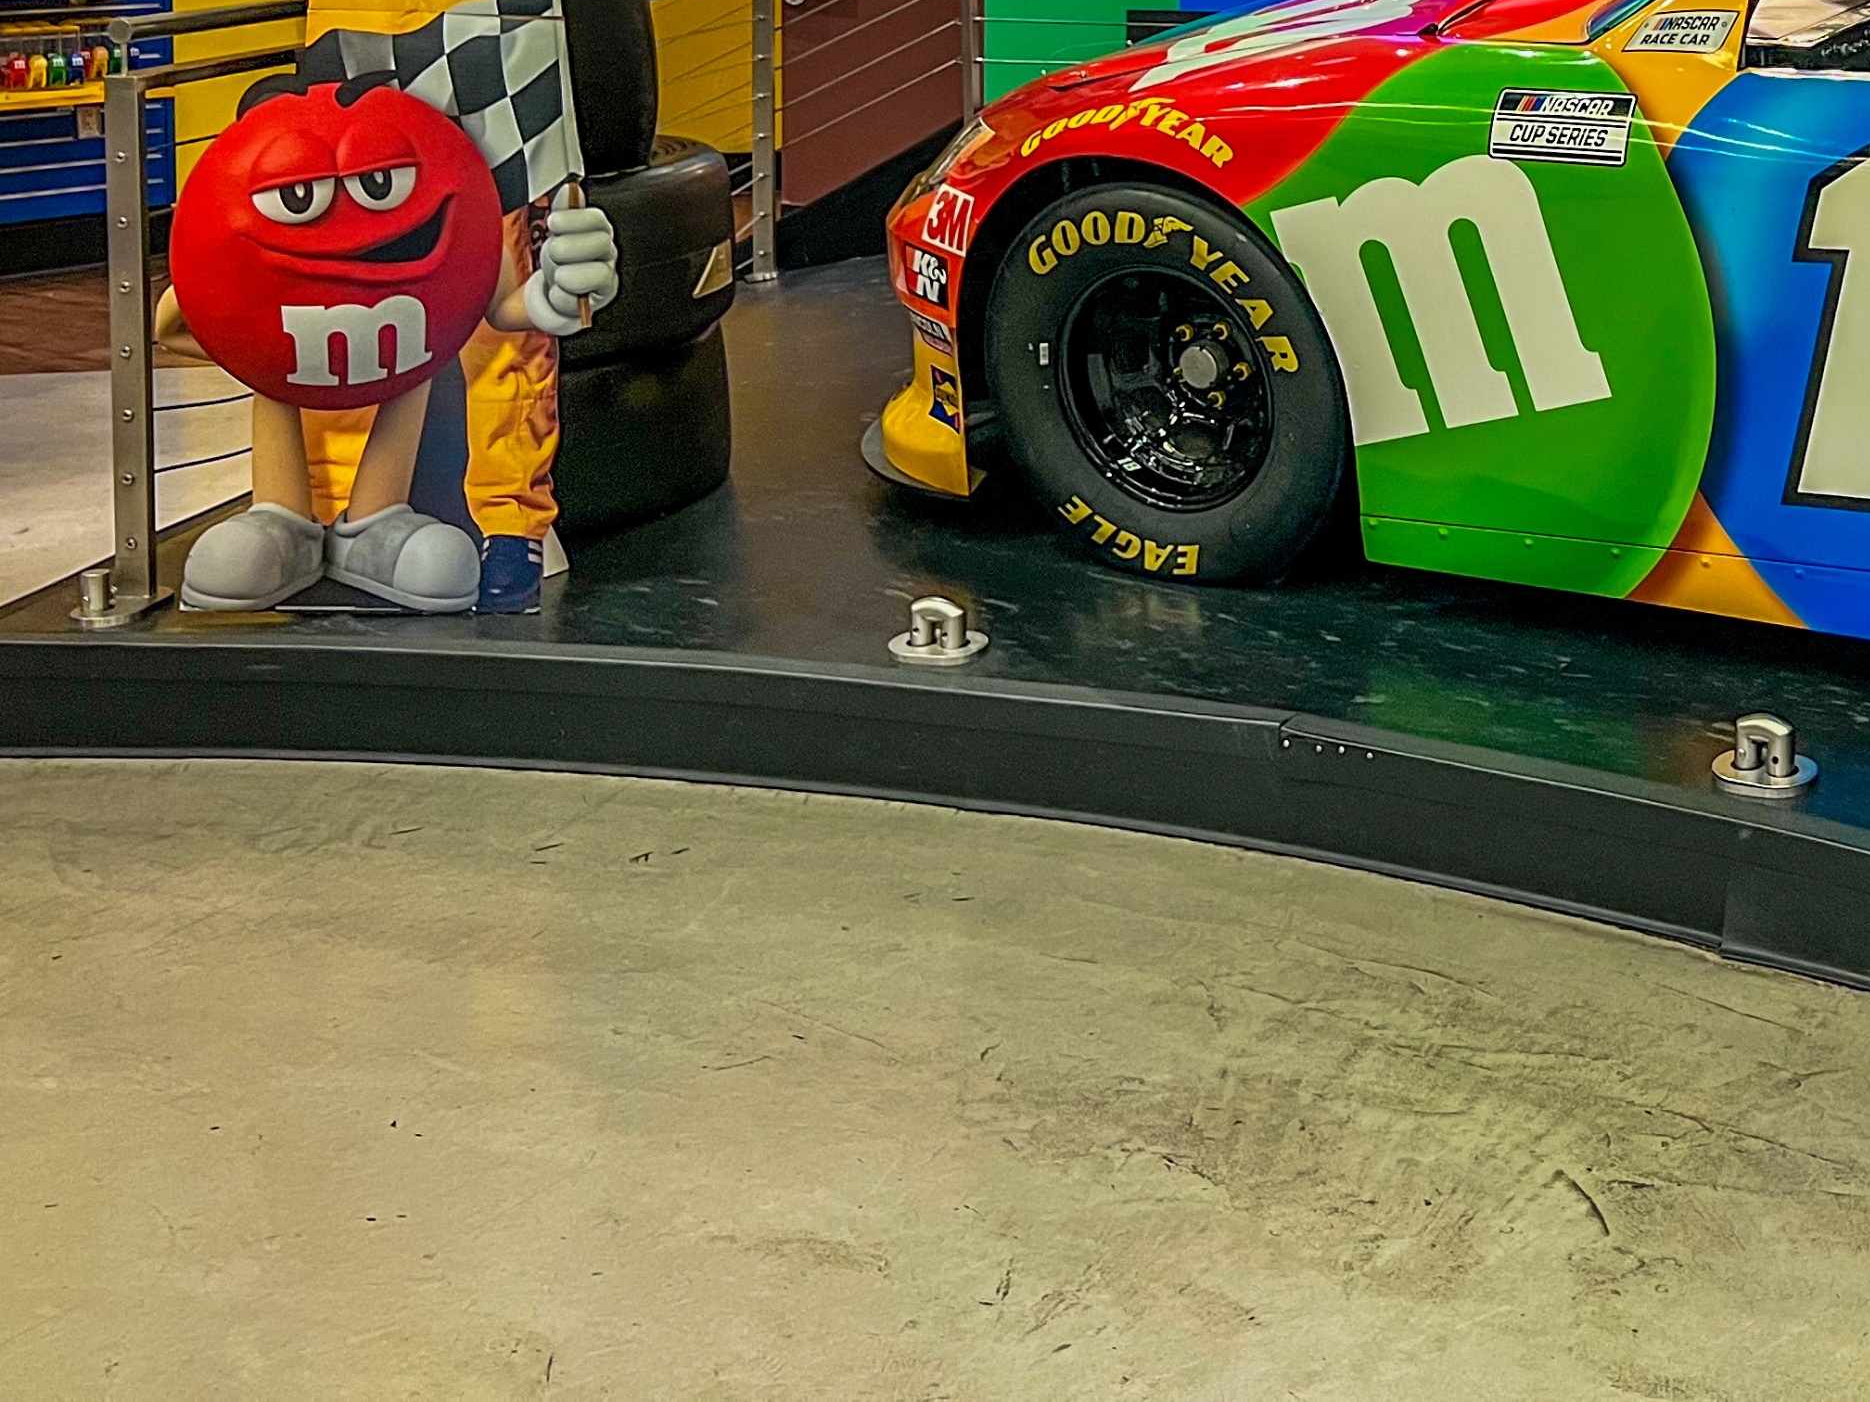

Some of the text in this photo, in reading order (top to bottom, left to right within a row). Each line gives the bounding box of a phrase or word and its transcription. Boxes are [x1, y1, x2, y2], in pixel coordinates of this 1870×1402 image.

[1664, 15, 1721, 31] NASCAR
[1639, 33, 1710, 46] RACE CAR
[1542, 95, 1615, 117] NASCAR
[1020, 97, 1234, 168] GOODYEAR
[1509, 123, 1609, 148] CUP SERIES
[926, 189, 972, 256] 3M
[1057, 494, 1200, 576] EAGLE
